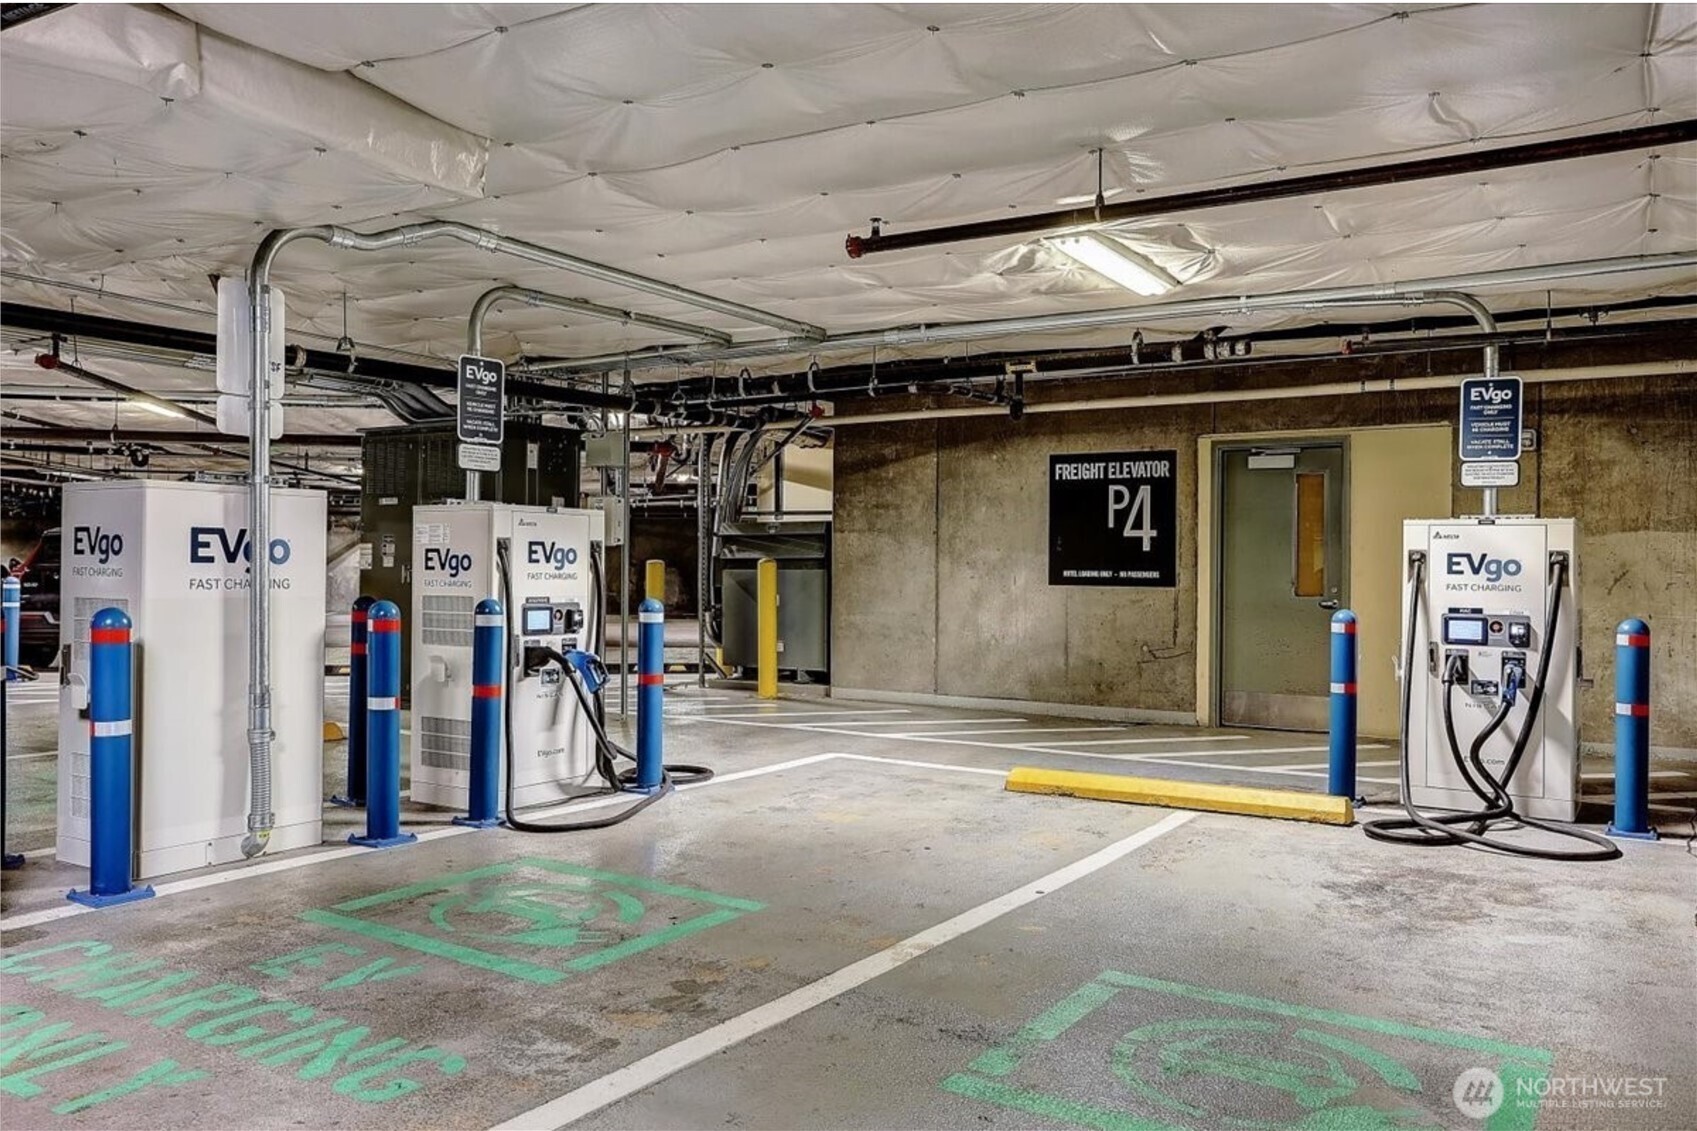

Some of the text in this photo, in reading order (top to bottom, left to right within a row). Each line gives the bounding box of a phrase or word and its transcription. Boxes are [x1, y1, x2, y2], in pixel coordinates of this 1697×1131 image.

[466, 365, 498, 384] EVgo
[1470, 387, 1512, 403] EVgo
[1055, 460, 1170, 480] FREIGHT ELEVATOR
[1108, 484, 1158, 552] P4
[73, 527, 124, 564] EVgo
[528, 541, 577, 570] EVgo
[72, 566, 123, 577] FAST CHARGING
[425, 548, 472, 578] EVgo
[1447, 553, 1522, 583] EVgo
[189, 578, 290, 590] FAST CHAING
[527, 572, 578, 581] FAST CHARGING
[1446, 584, 1523, 593] FAST CHARGING
[248, 941, 426, 991] EV
[0, 939, 468, 1103] CHARGING
